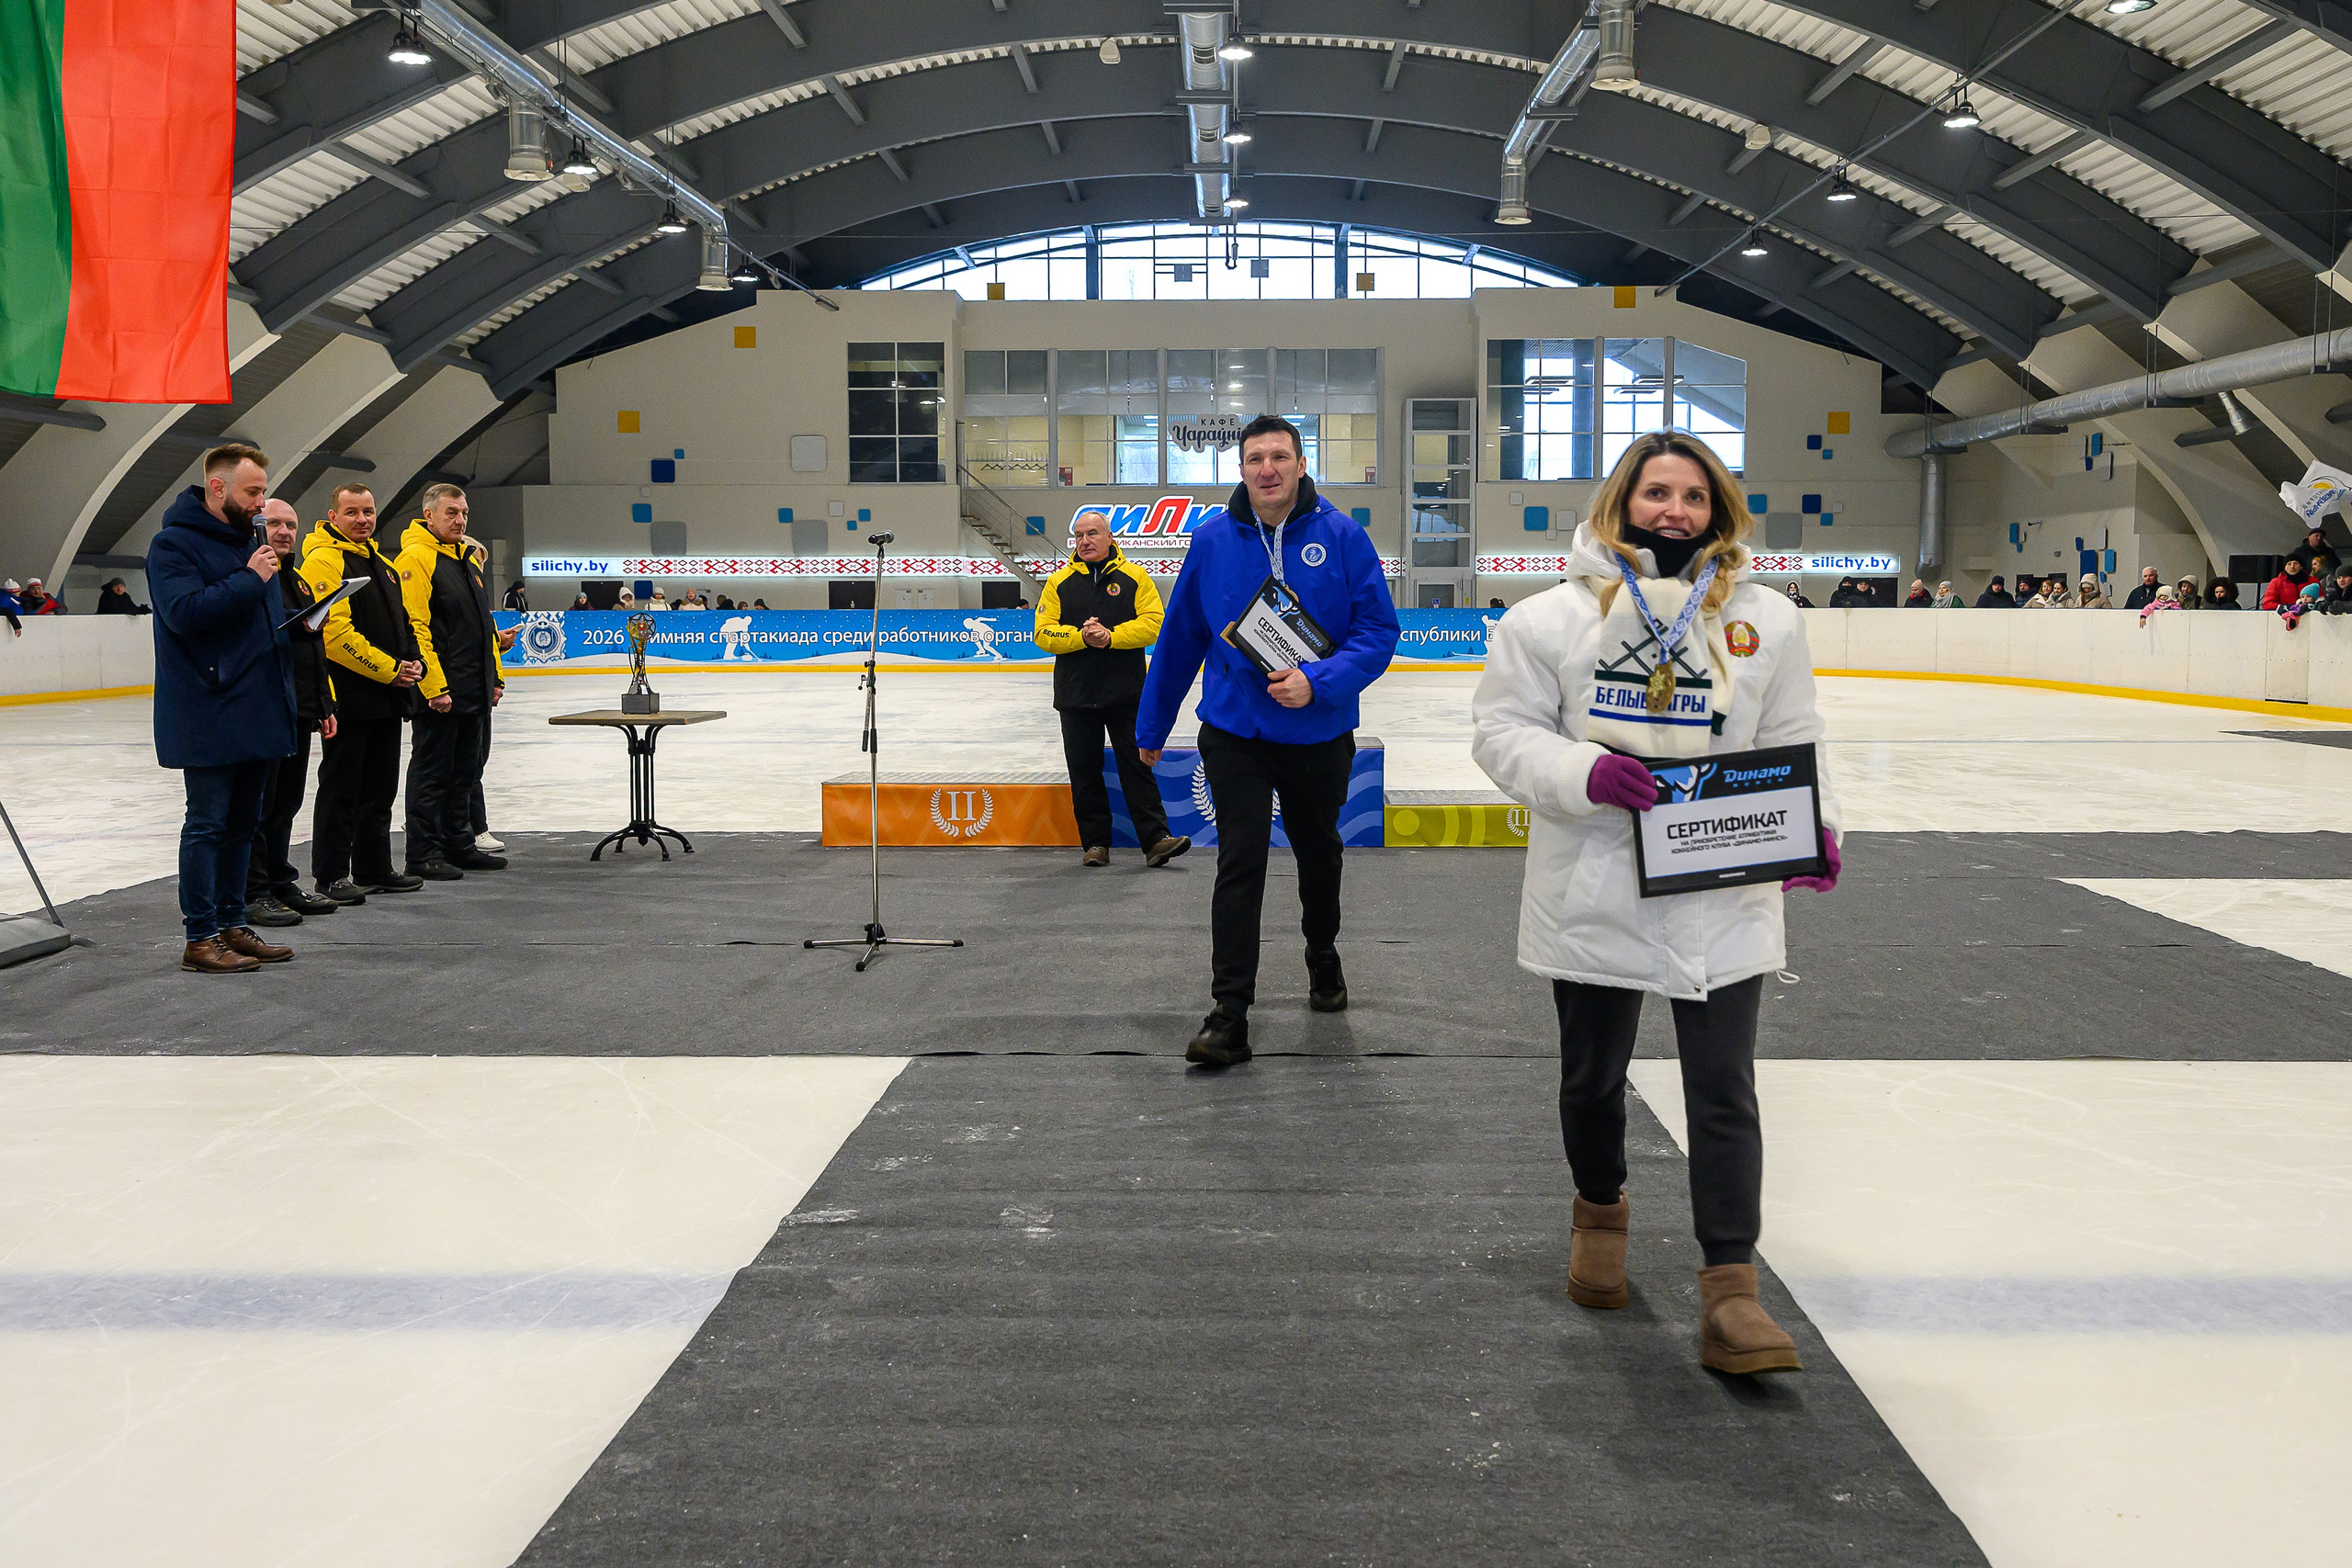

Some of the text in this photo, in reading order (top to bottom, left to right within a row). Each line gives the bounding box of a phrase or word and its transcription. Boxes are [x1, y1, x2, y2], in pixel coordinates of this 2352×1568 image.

[1201, 418, 1235, 426] КАФЕ
[1172, 424, 1241, 449] Чараўні
[1069, 538, 1176, 547] РИКАНСКИЙ
[531, 559, 608, 573] silichy.by
[1812, 556, 1891, 570] silichy.by
[582, 629, 625, 645] 2026
[648, 631, 705, 644] имняя
[709, 631, 819, 647] спартакиада
[822, 631, 874, 646] среди
[878, 627, 979, 646] работников
[983, 630, 1034, 646] орган
[1399, 626, 1481, 646] спублики
[1258, 616, 1305, 661] СЕРТИФИКА
[343, 642, 380, 672] BELARUS
[1595, 685, 1647, 711] БЕЛЫЕ
[946, 791, 977, 821] II
[1667, 809, 1788, 840] СЕРТИФИКАТ
